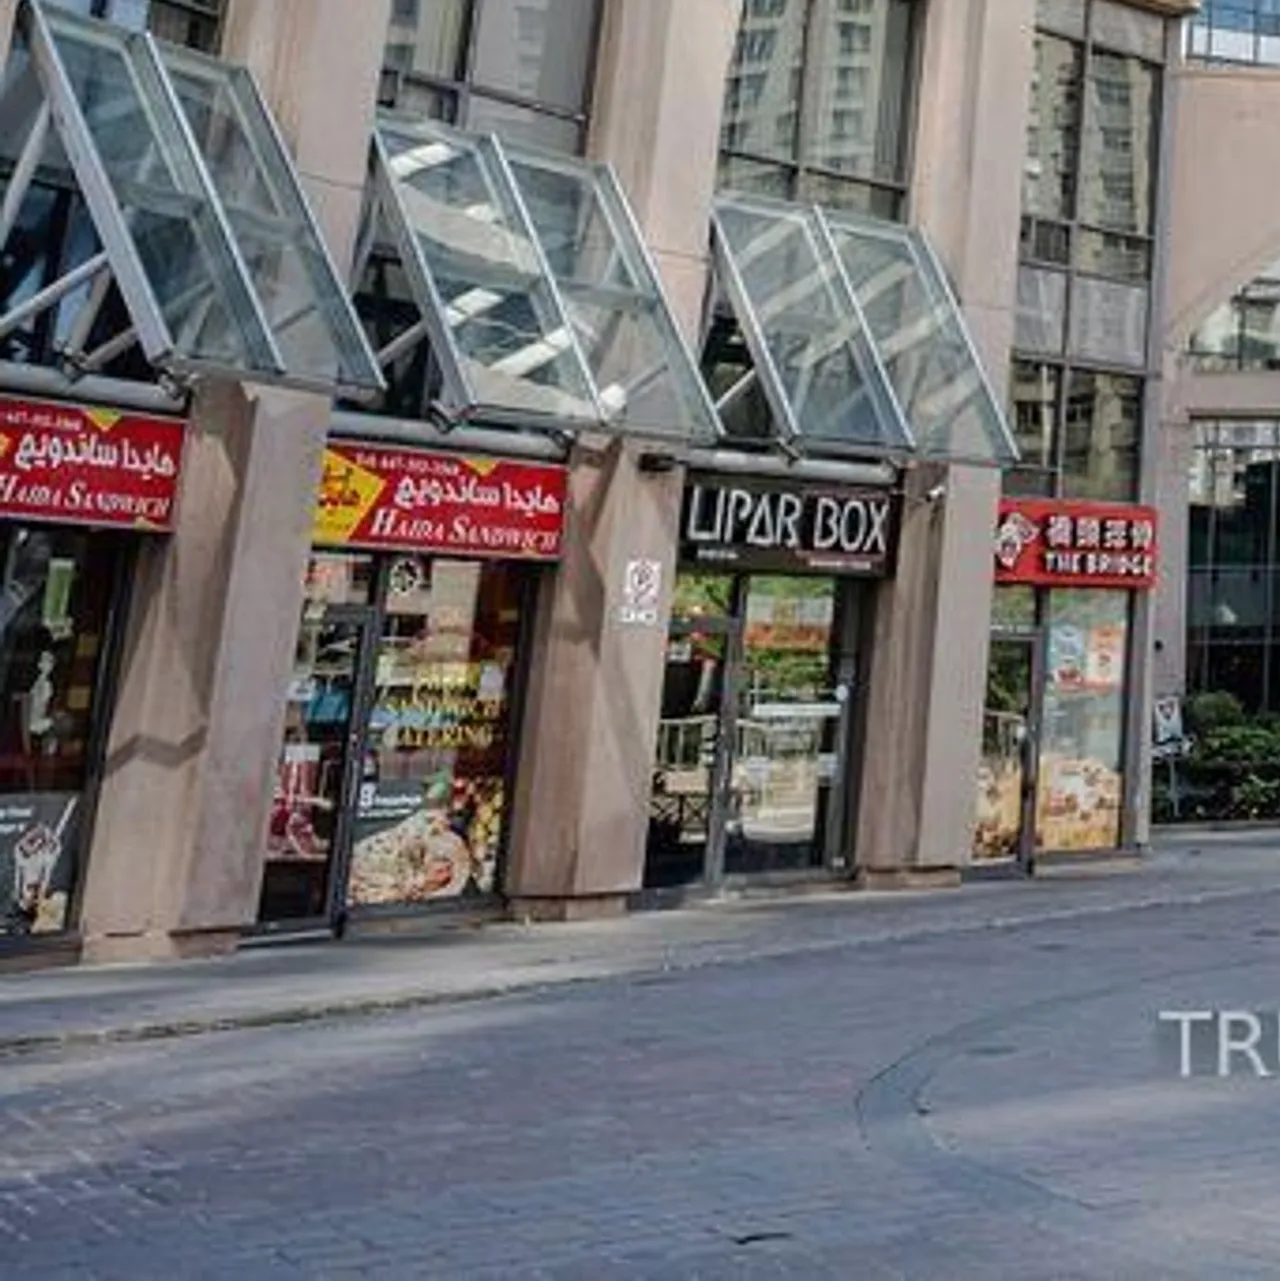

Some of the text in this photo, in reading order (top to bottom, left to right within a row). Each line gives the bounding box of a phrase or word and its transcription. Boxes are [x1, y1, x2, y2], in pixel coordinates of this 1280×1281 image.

[369, 508, 559, 551] HAIDA SANDWICH
[814, 497, 890, 553] BOX
[1045, 551, 1152, 576] THE BRIDGE
